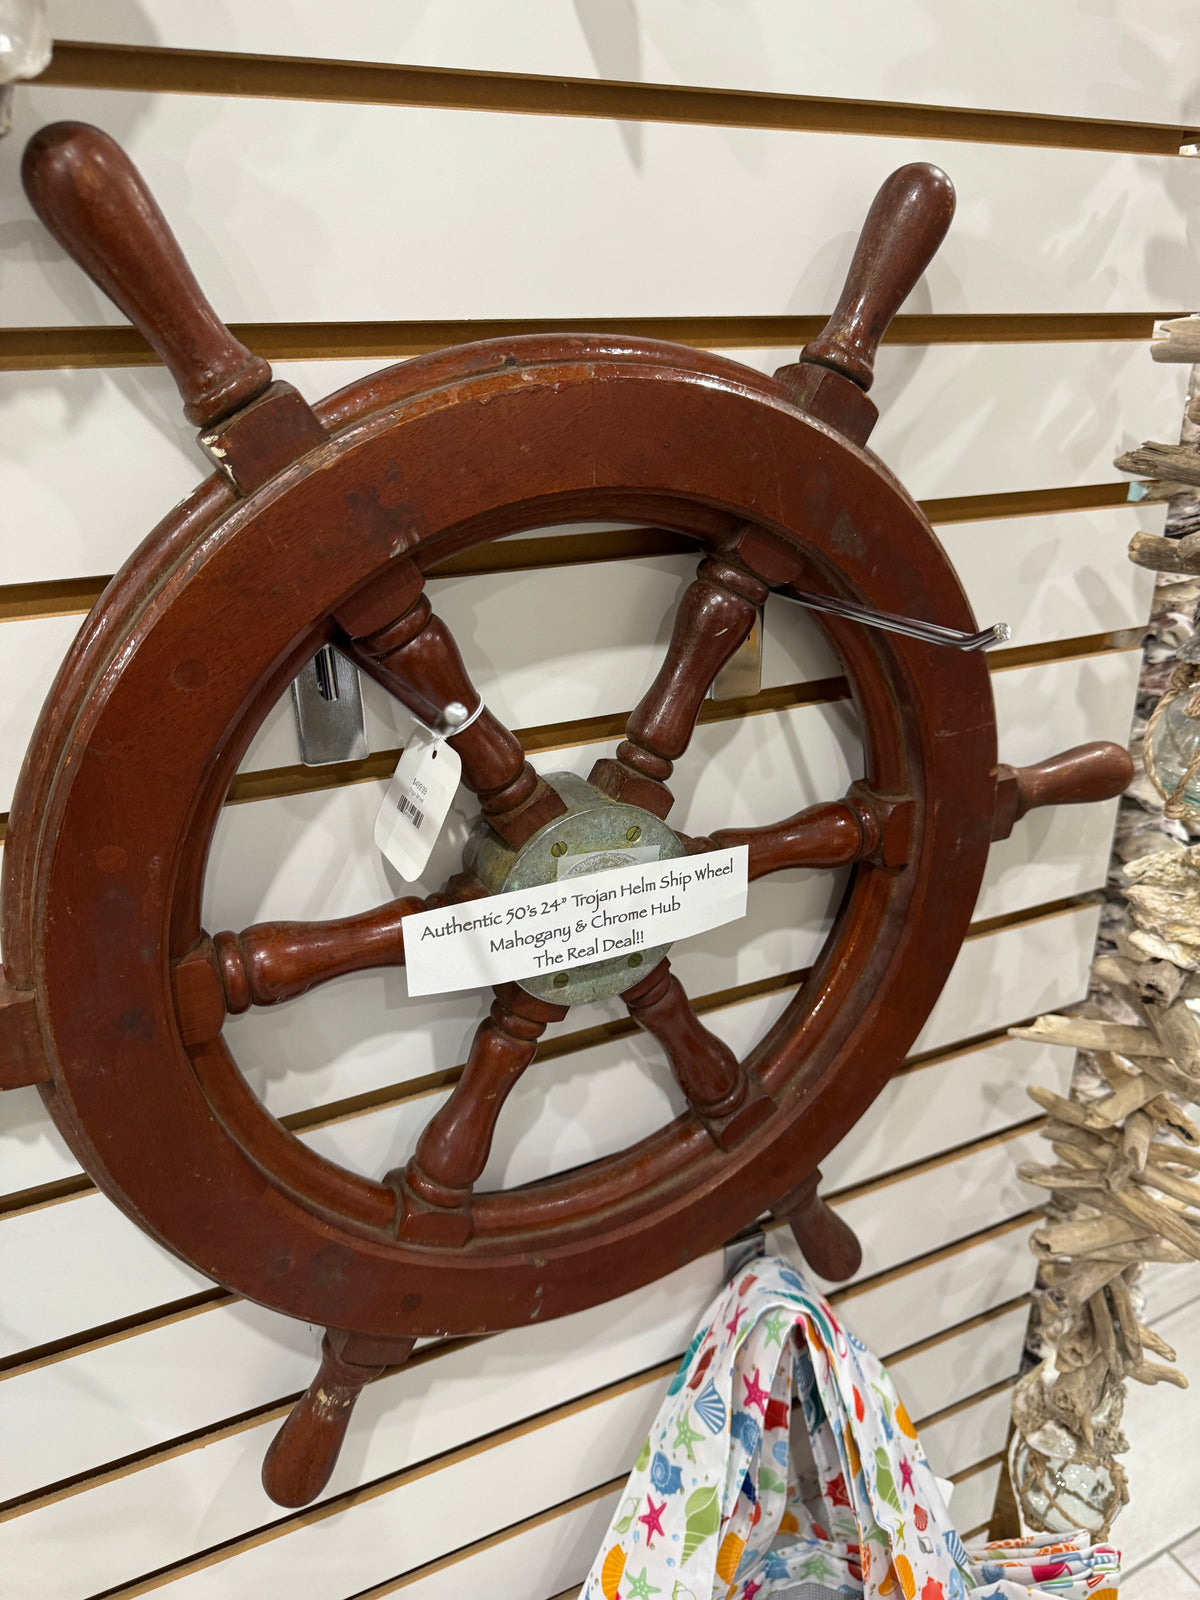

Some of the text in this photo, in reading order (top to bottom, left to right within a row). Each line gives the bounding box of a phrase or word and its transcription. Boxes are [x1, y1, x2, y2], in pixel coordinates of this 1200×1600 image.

[421, 858, 732, 940] Authentic 50's 24" Trojan Helm Ship Wheel
[491, 896, 680, 952] Mahogany & Chrome Hub
[533, 929, 644, 968] The Real Deal!!
